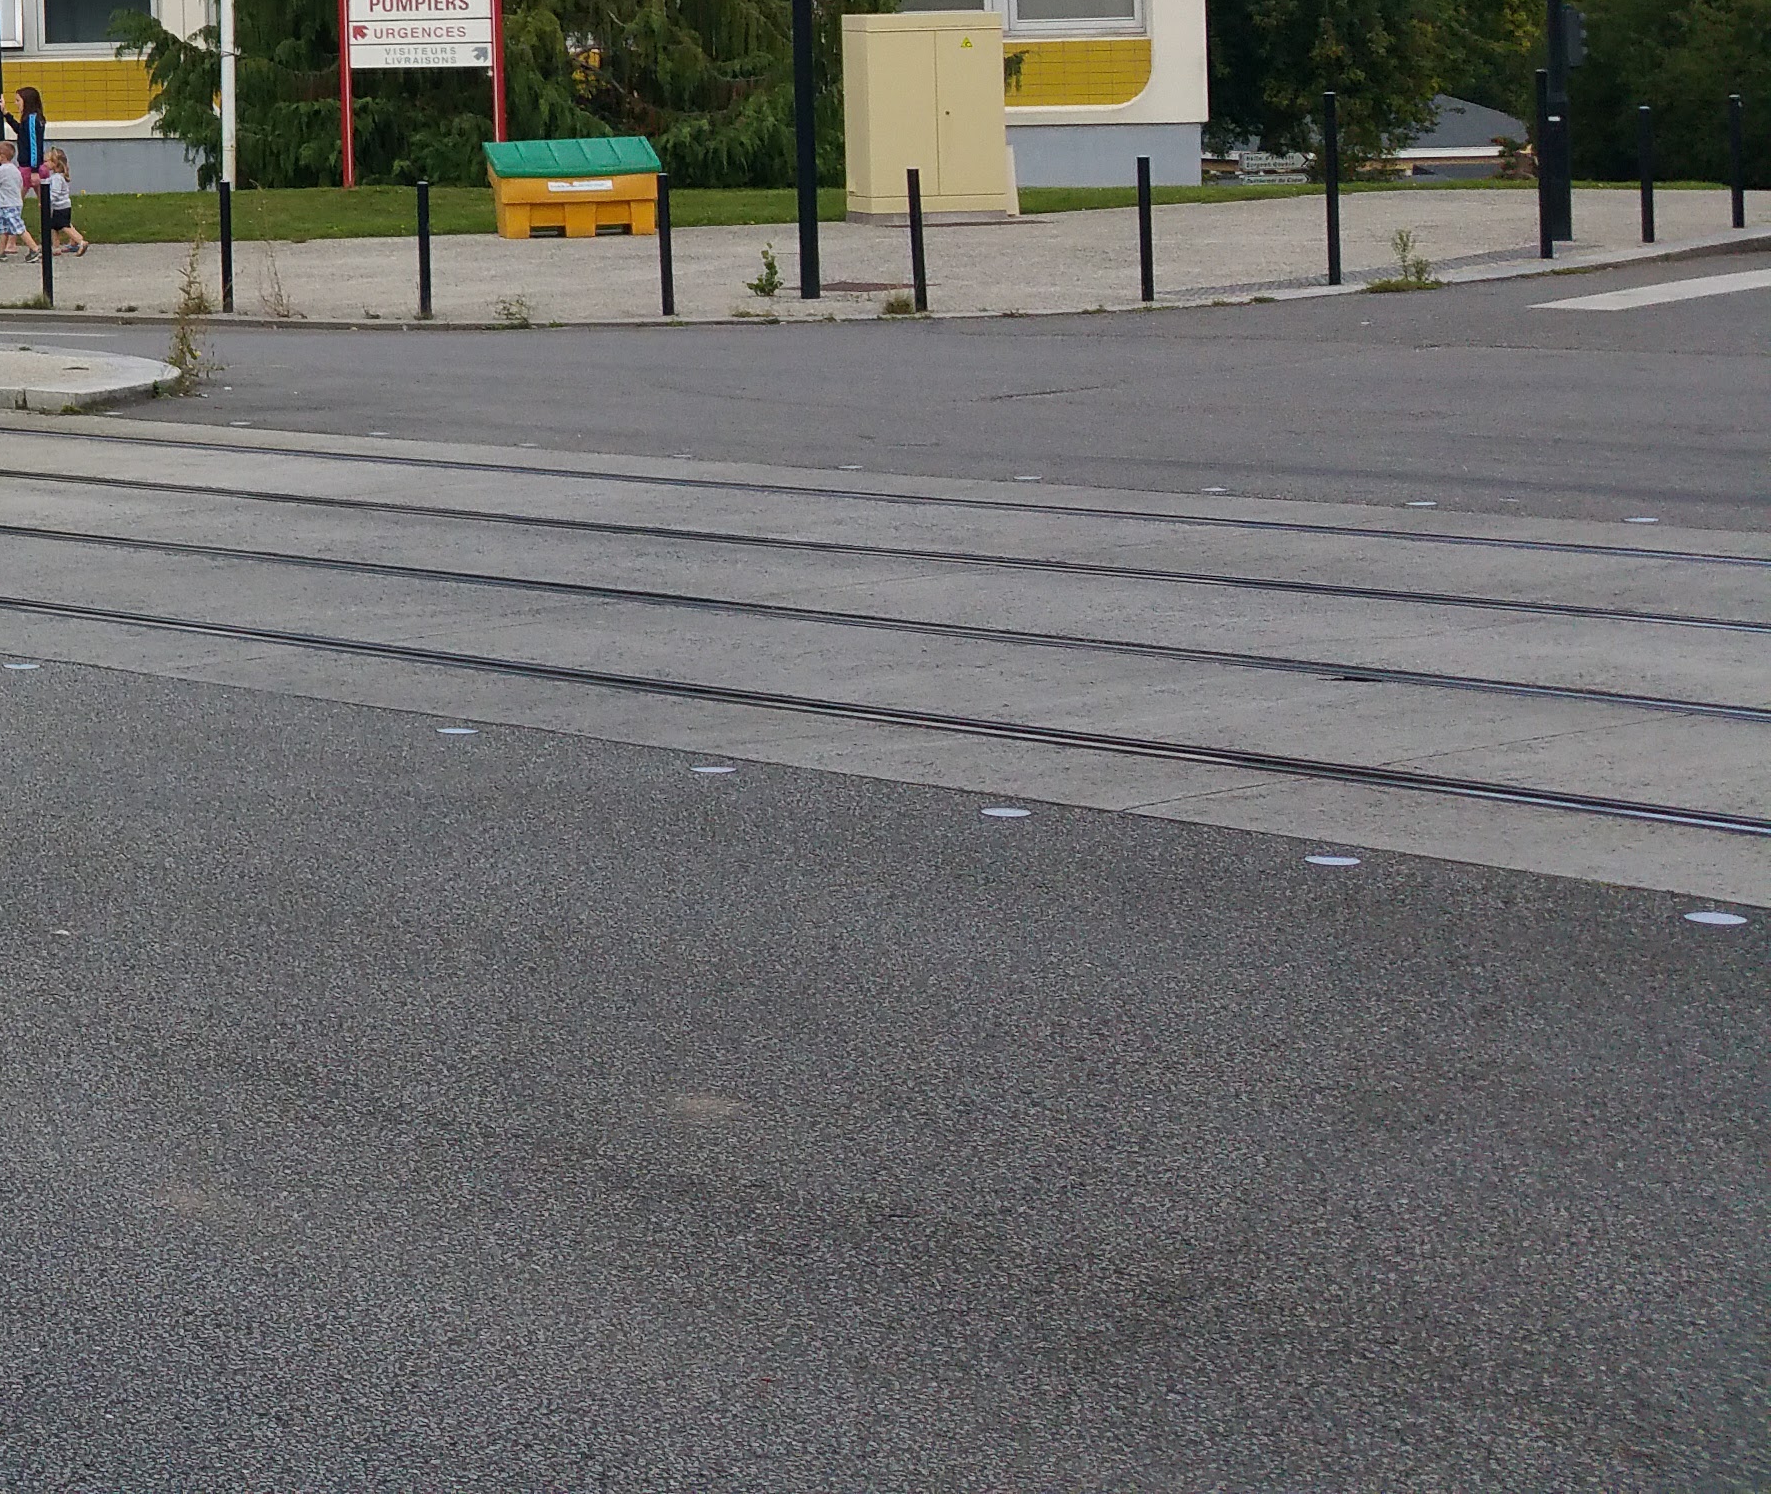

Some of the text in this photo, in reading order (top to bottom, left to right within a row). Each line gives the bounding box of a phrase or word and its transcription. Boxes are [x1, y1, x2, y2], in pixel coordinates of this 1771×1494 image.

[374, 26, 467, 39] URGENCES
[384, 47, 457, 56] VISITEURS
[385, 56, 457, 65] LIVRAISONS
